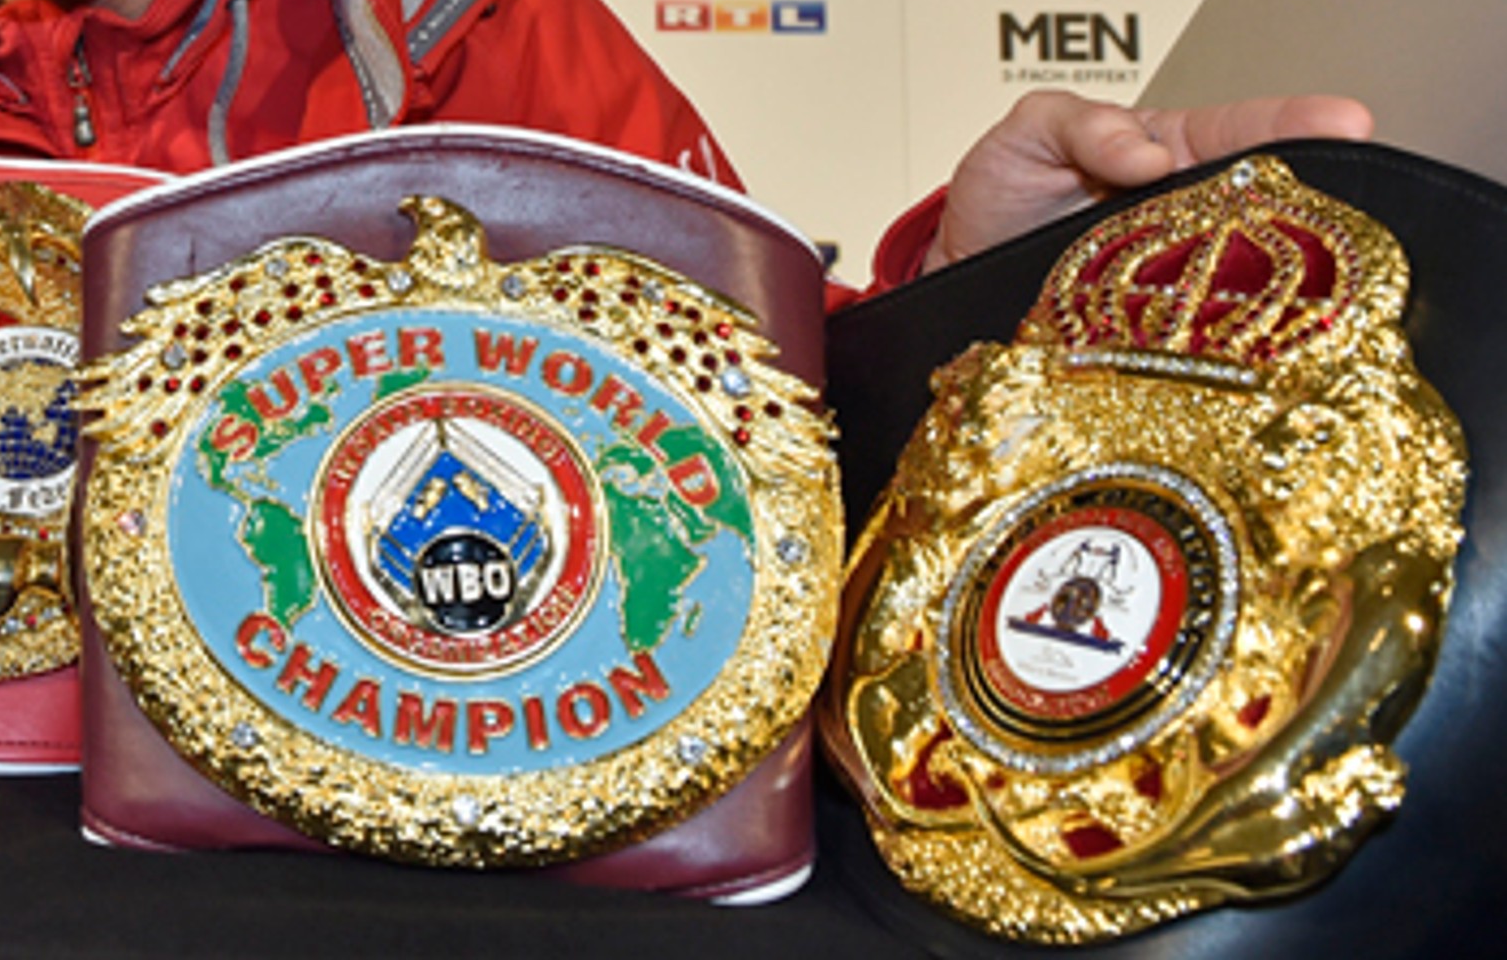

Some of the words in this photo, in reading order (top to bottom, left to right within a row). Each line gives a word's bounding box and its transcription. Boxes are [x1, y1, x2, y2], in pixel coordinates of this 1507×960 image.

[658, 1, 824, 30] RTL
[998, 11, 1140, 62] MEN
[212, 327, 445, 462] SUPER
[473, 329, 720, 508] WORLD
[421, 561, 512, 605] WBO
[235, 613, 672, 754] CHAMPION
